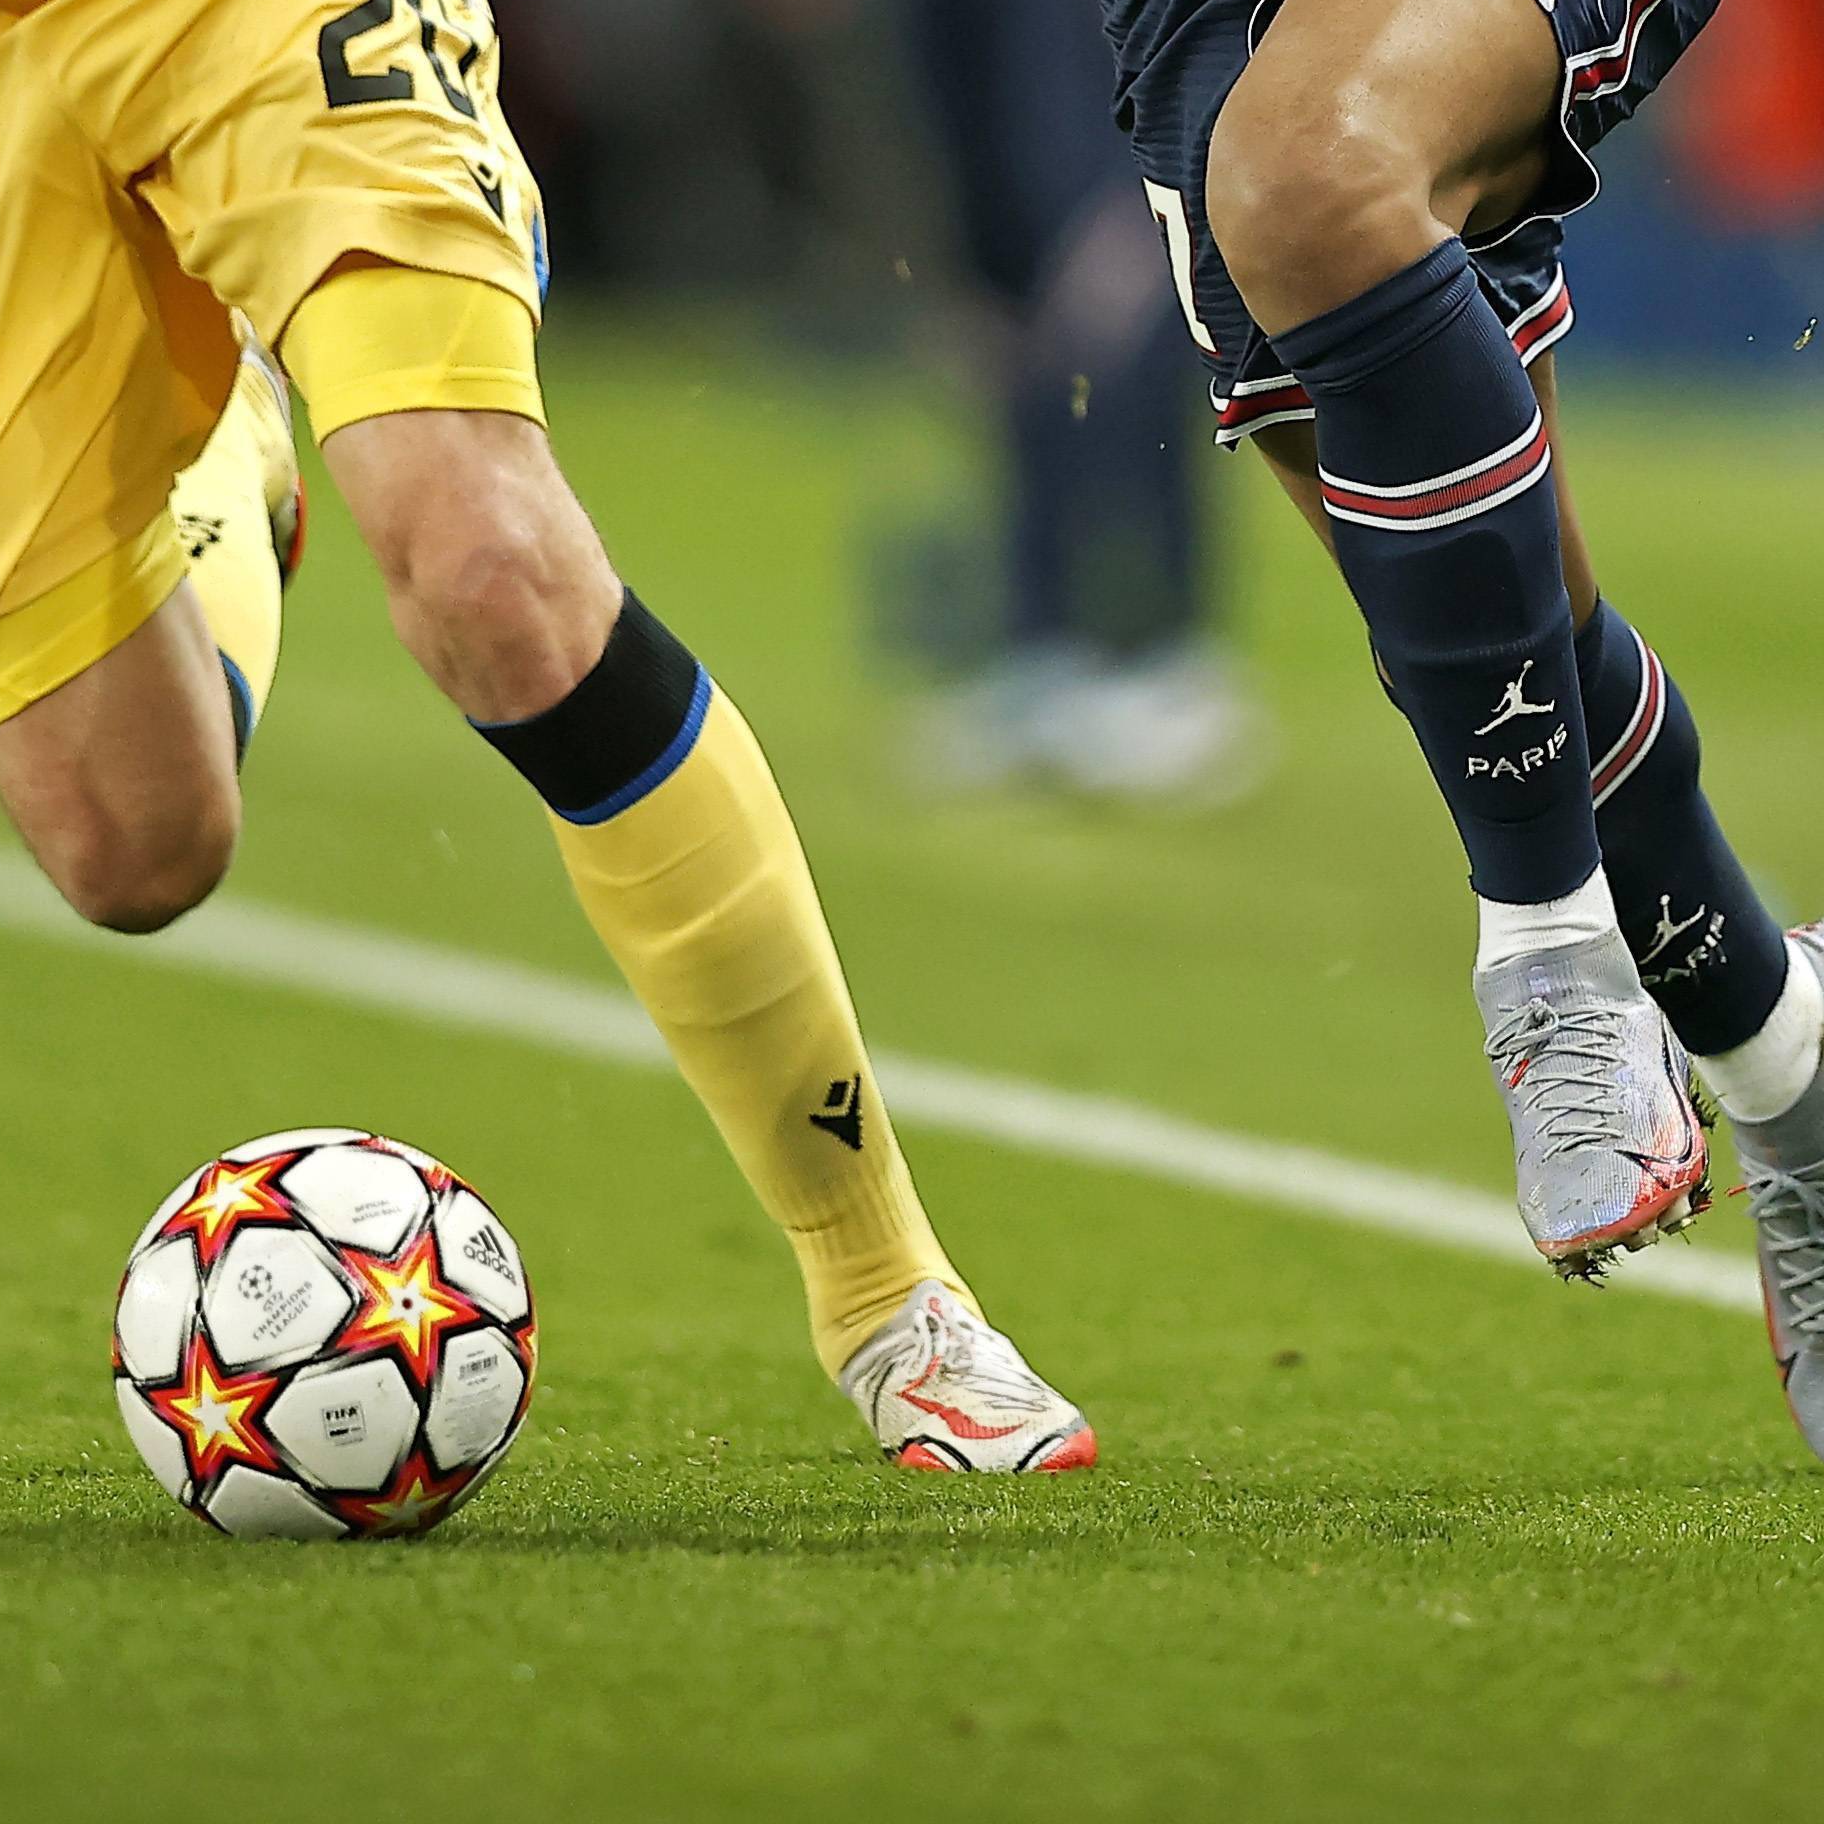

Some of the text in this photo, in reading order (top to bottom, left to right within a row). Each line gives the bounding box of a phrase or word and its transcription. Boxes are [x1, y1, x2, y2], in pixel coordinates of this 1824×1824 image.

[1141, 175, 1219, 355] 7
[1464, 722, 1567, 783] PARIS
[462, 1243, 518, 1287] adidas
[325, 1406, 359, 1421] FIFA
